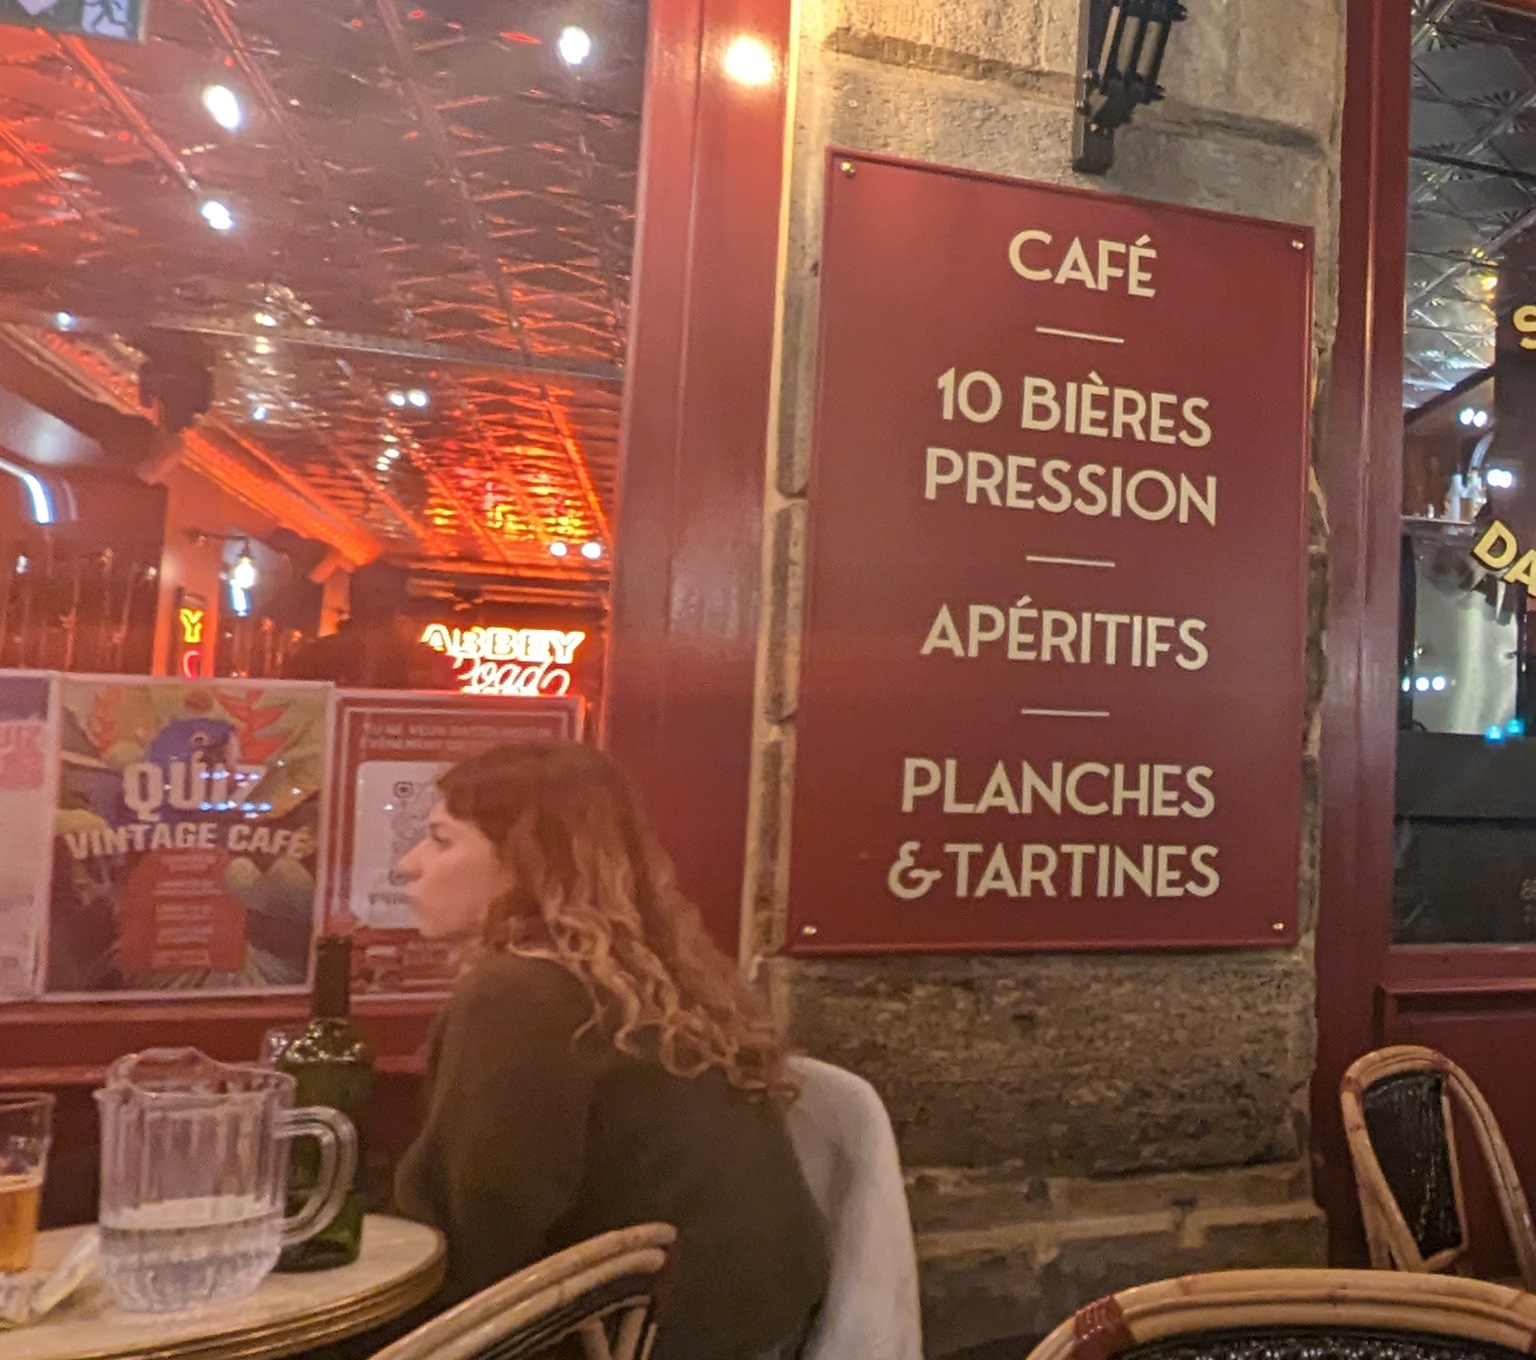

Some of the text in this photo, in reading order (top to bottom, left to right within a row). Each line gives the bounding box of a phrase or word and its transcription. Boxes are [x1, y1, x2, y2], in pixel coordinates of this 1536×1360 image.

[1009, 229, 1157, 298] CAFÉ
[937, 368, 1212, 447] 10 BIÈRES
[924, 446, 1217, 526] PRESSION
[421, 623, 586, 665] ABBEY
[920, 595, 1209, 670] APÉRITIFS
[901, 758, 1215, 818] PLANCHES
[65, 822, 218, 860] VINTAGE
